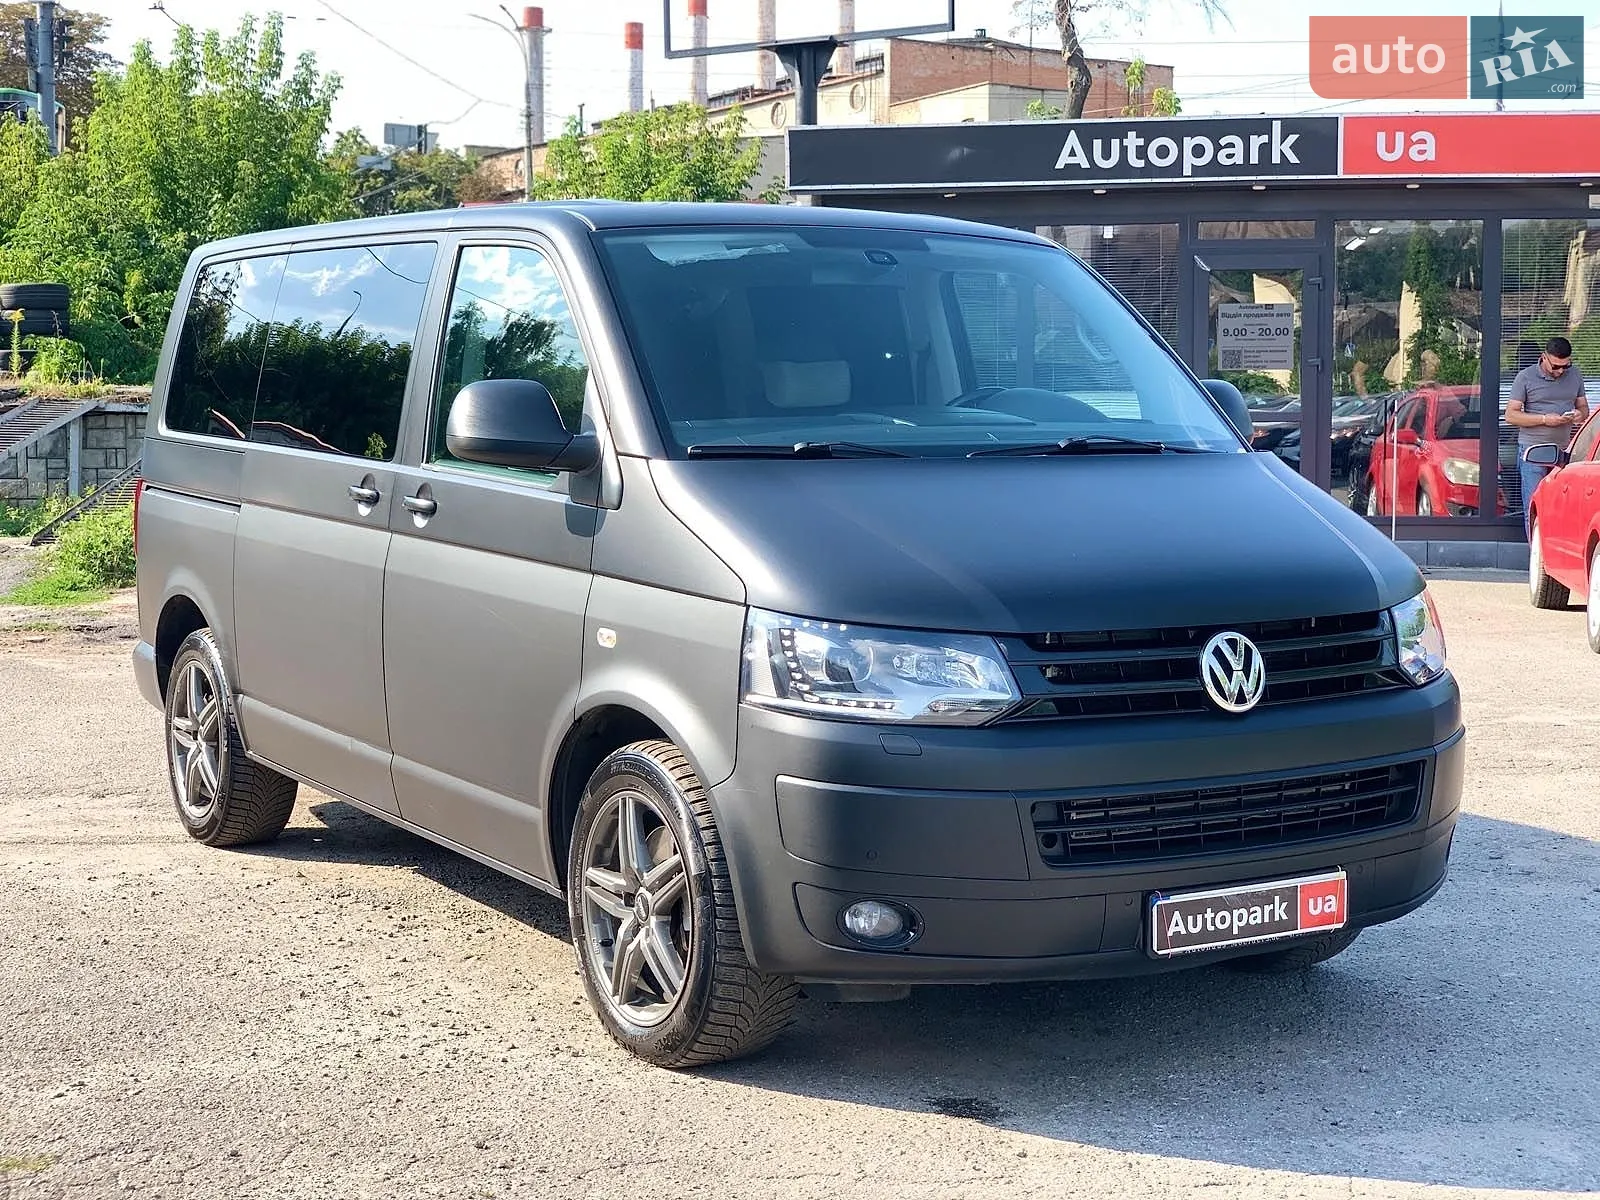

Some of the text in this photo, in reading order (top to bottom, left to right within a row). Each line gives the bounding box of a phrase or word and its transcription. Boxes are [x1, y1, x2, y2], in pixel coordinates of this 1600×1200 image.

[1054, 119, 1437, 177] Autopark ua
[1222, 327, 1247, 336] 9.00
[1258, 327, 1289, 336] 20.00
[1167, 893, 1337, 937] Autopark ua
